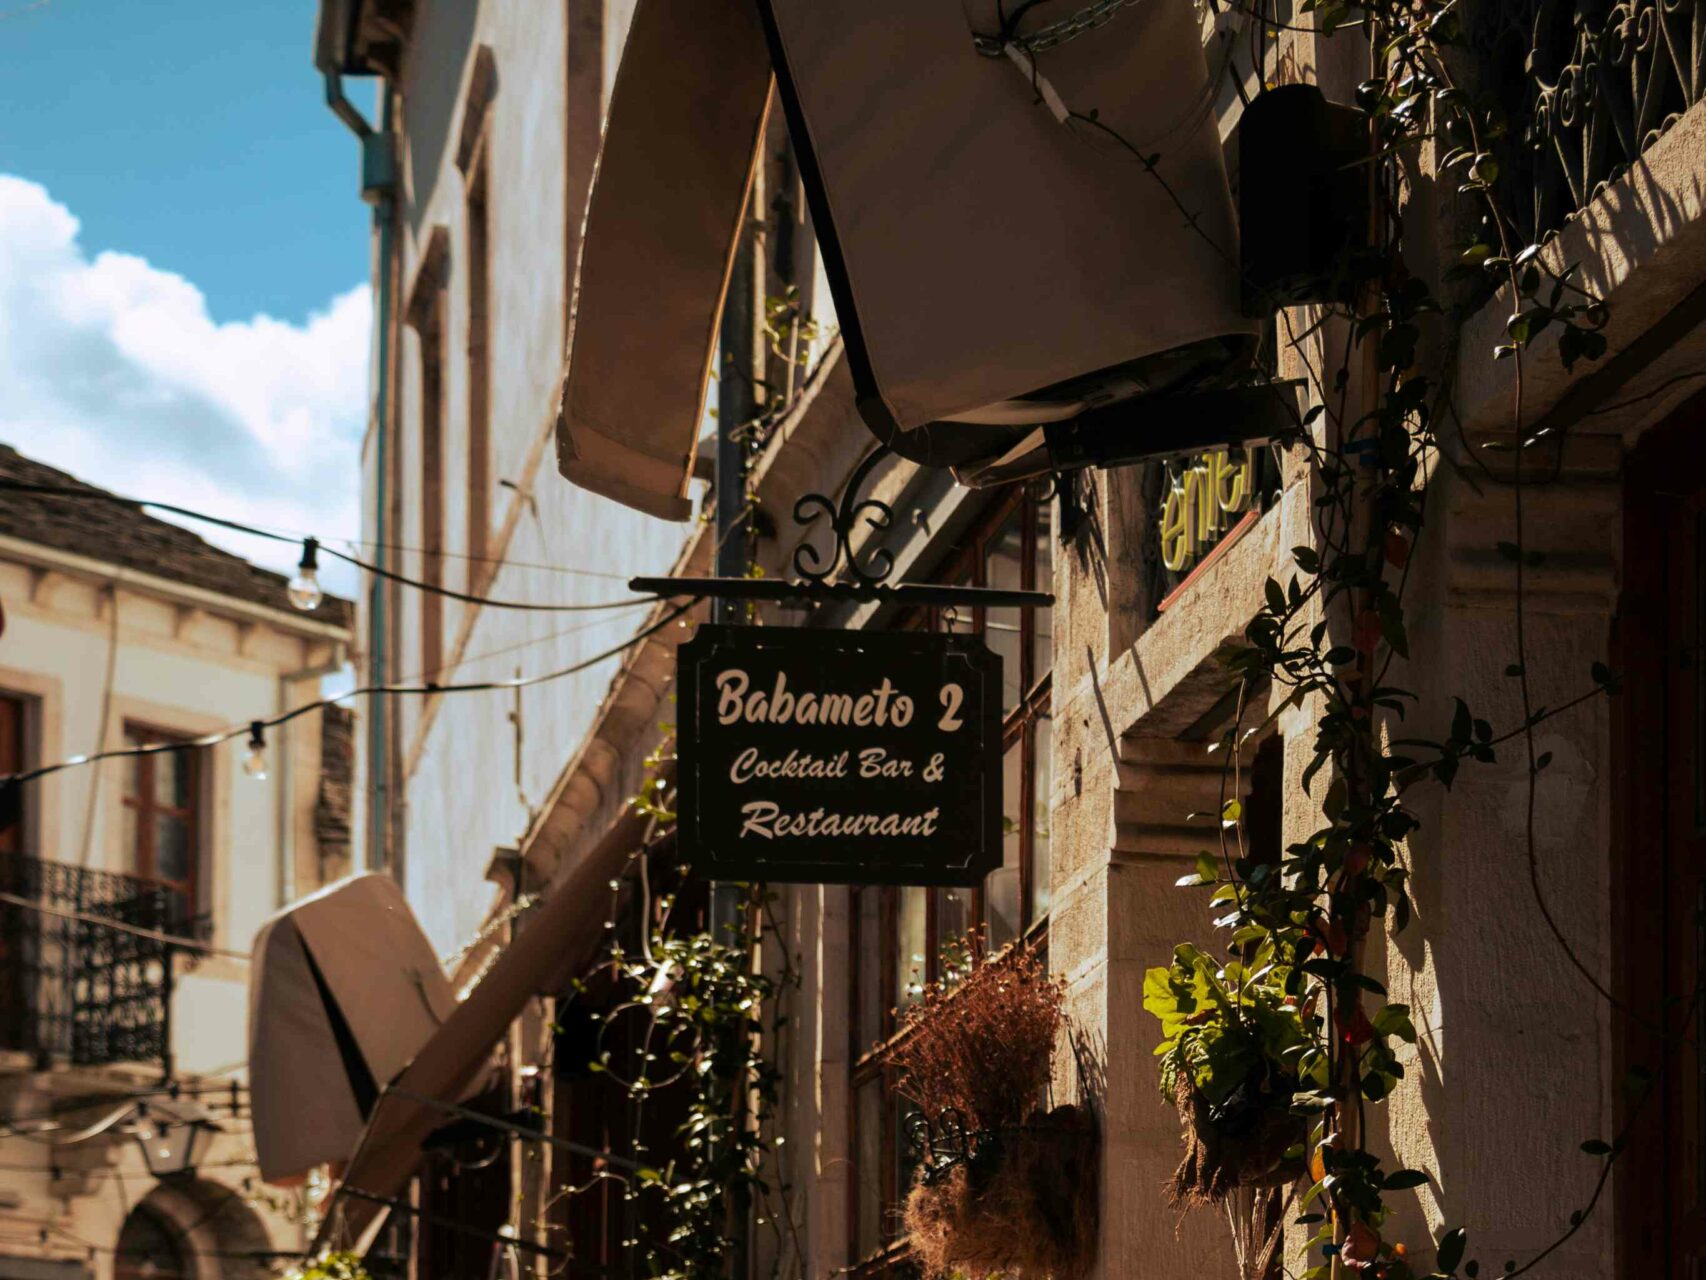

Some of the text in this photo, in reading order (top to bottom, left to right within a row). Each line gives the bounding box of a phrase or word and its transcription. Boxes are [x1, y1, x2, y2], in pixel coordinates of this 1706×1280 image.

[716, 669, 964, 731] Babameto 2
[729, 747, 945, 784] Cocktail Bar &
[739, 800, 940, 838] Restaurant
